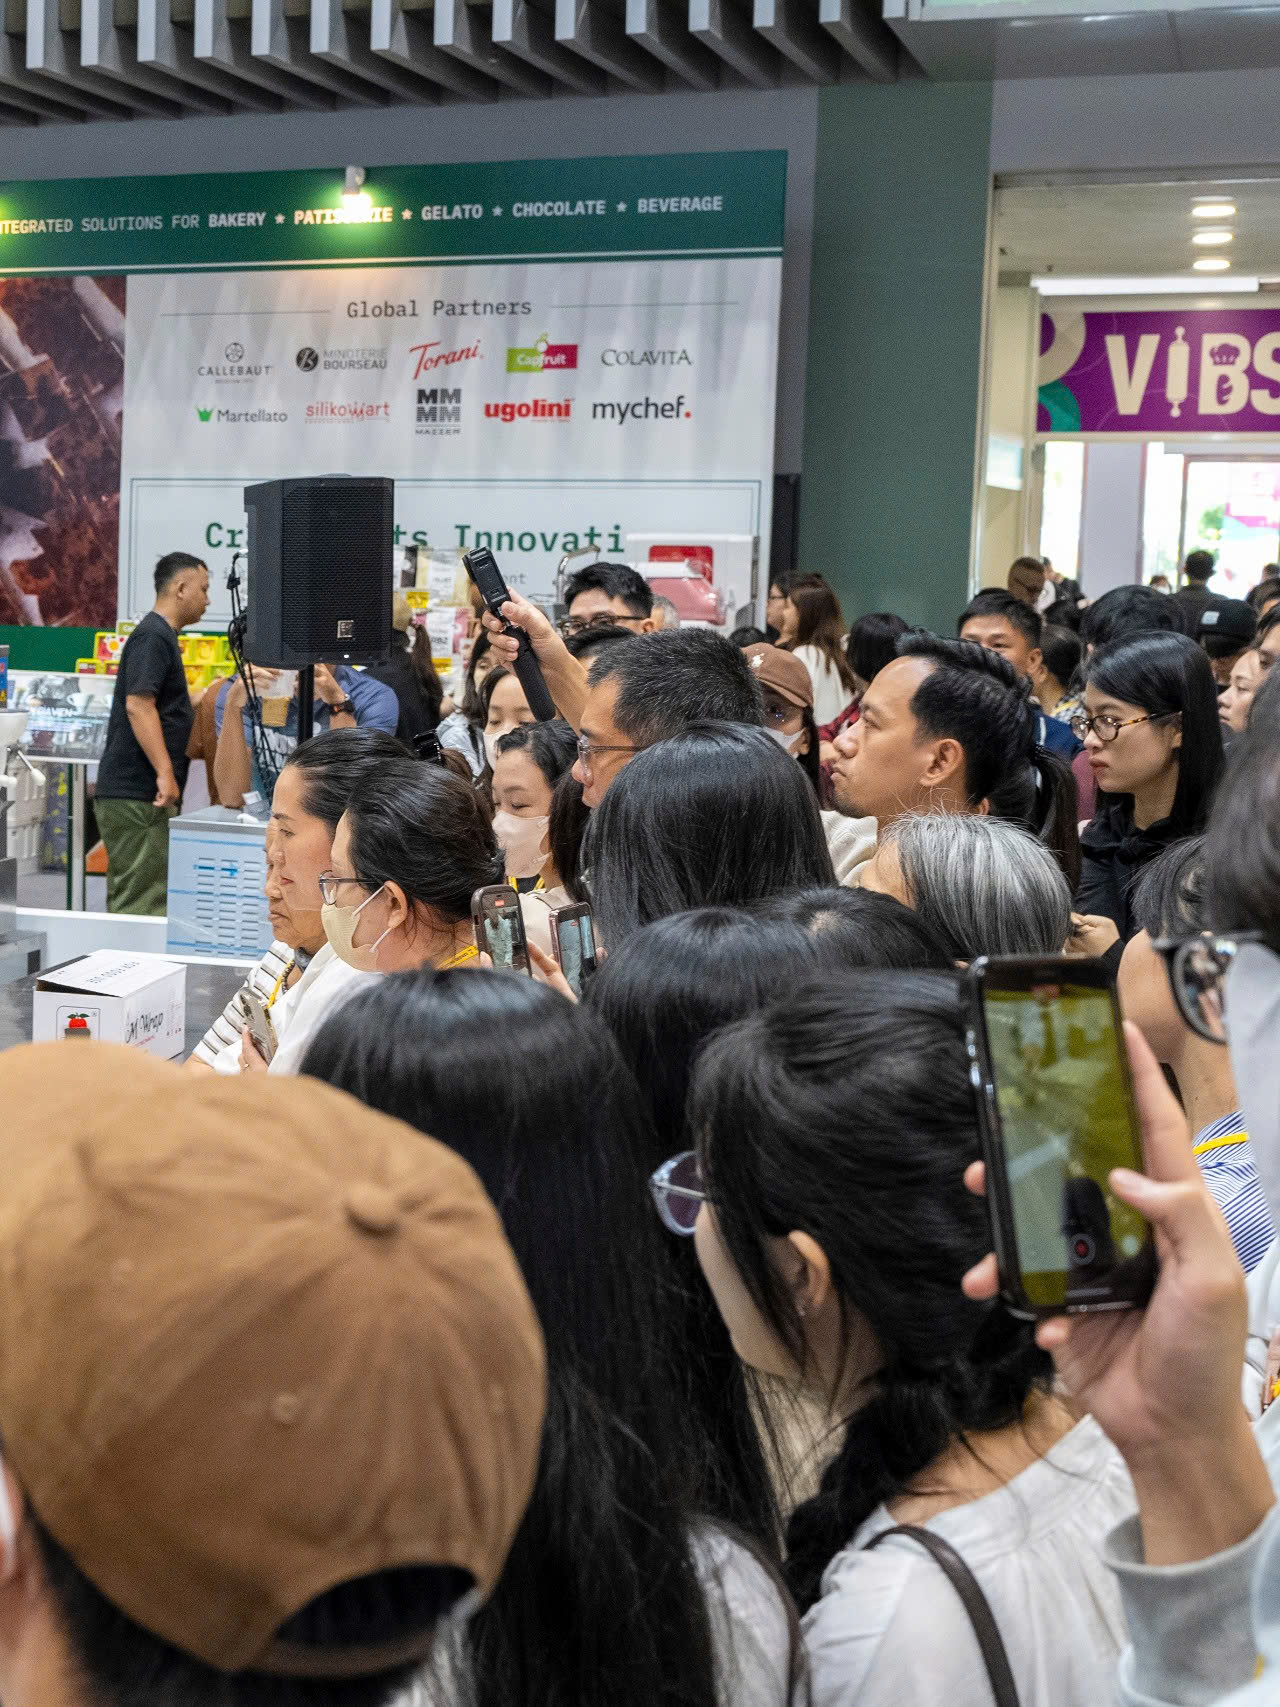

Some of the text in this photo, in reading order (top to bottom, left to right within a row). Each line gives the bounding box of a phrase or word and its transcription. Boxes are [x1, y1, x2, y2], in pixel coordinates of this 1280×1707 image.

[81, 215, 163, 232] SOLUTIONS
[171, 214, 200, 228] FOR
[208, 211, 266, 228] BAKERY
[421, 204, 483, 221] GELATO
[512, 200, 606, 217] CHOCOLATE
[637, 196, 723, 214] BEVERAGE
[346, 300, 532, 318] Global Partners
[323, 359, 388, 371] BOURSEAU
[409, 339, 481, 381] Torani
[197, 365, 270, 377] CALLEBAUT
[217, 409, 288, 423] Martellato
[484, 399, 572, 422] ugolini
[454, 524, 624, 552] Innovati
